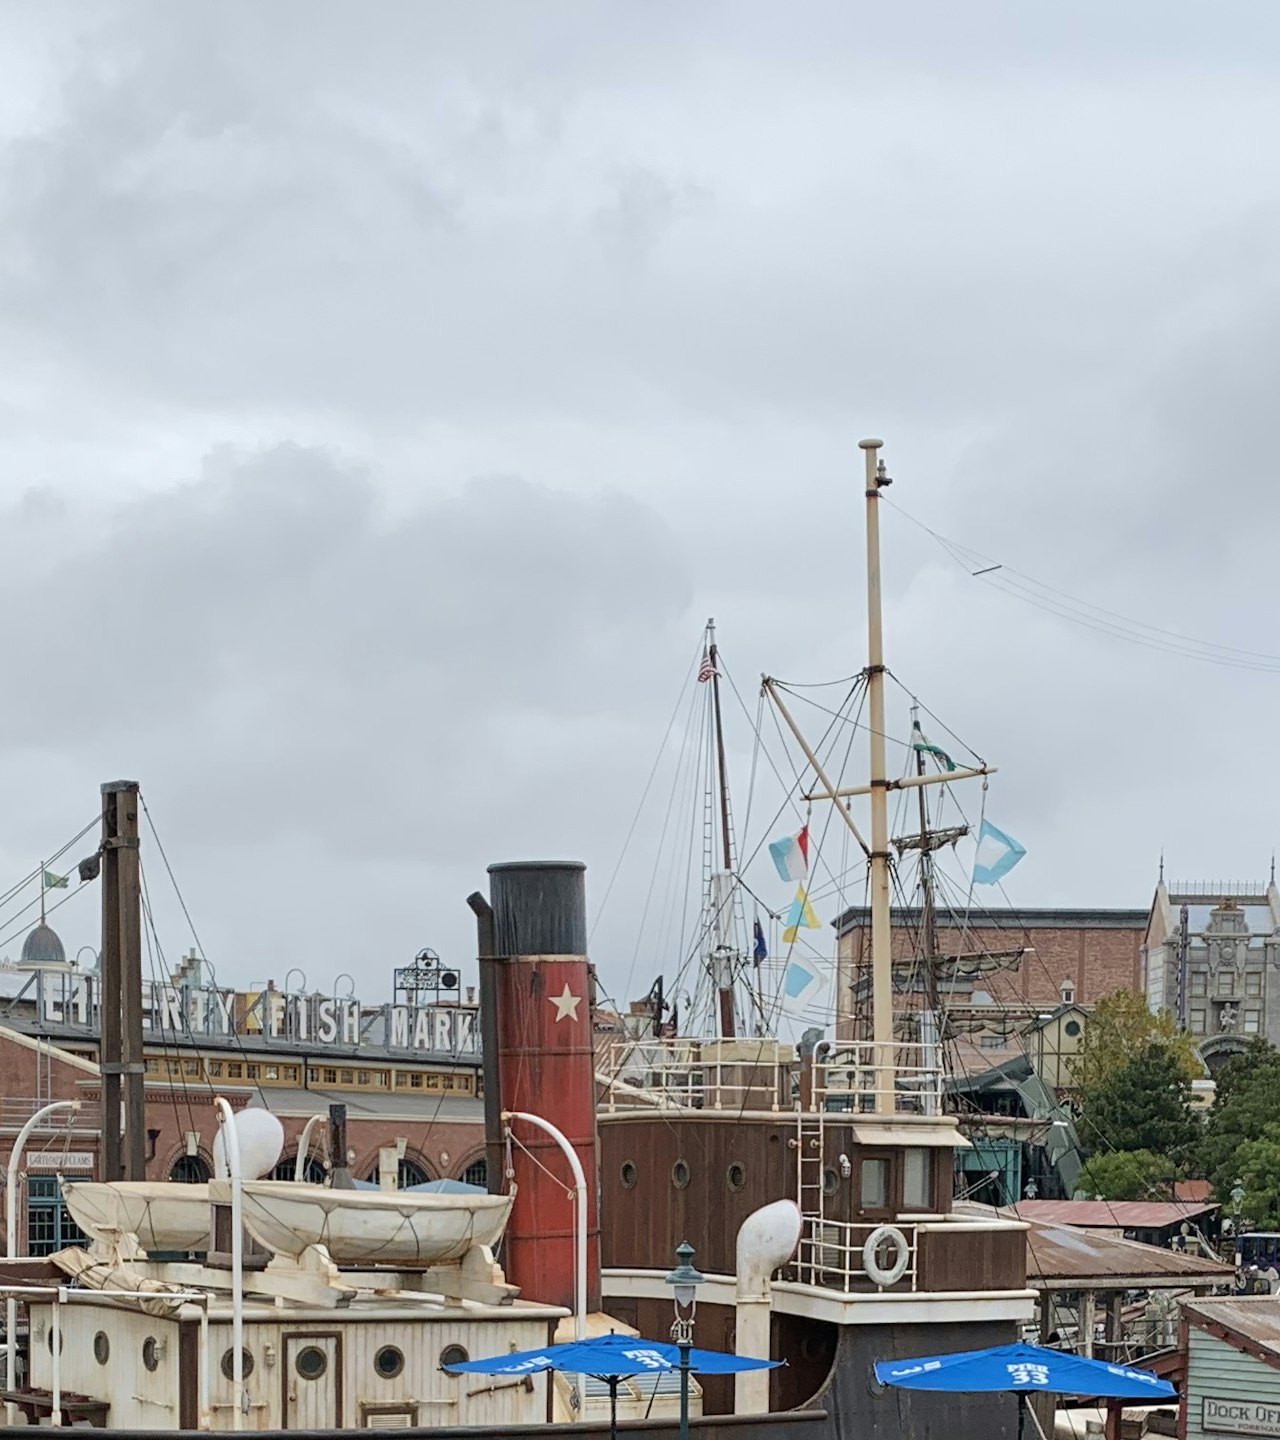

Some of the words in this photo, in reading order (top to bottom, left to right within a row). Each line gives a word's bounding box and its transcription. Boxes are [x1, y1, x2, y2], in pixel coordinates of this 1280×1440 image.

[270, 994, 360, 1046] FISH
[391, 1006, 473, 1053] MARK
[636, 1357, 672, 1369] 33
[1006, 1362, 1050, 1374] PIER
[1011, 1371, 1049, 1384] 33
[1207, 1401, 1251, 1421] DOCK
[1237, 1423, 1280, 1433] FOREMAN
